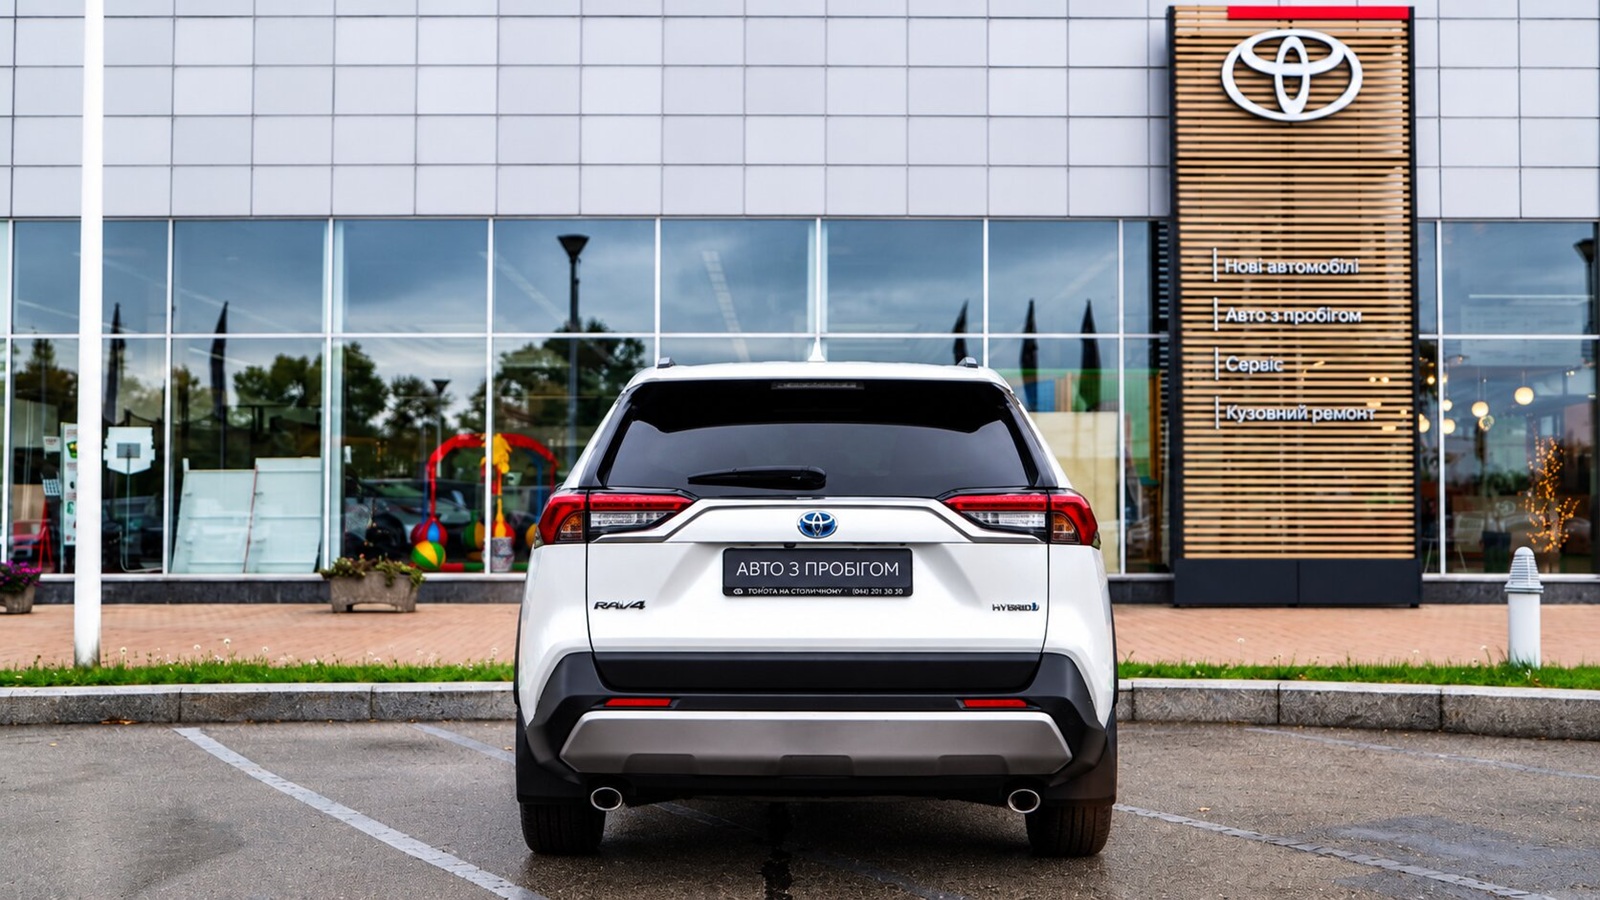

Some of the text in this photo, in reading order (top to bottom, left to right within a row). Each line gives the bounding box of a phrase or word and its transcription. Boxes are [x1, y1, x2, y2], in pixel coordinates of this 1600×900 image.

[1224, 258, 1360, 274] Нові автомобілі
[1225, 306, 1362, 325] Авто з пробігом
[1225, 355, 1284, 375] Сервіс
[1226, 404, 1376, 424] Кузовний ремонт
[736, 561, 900, 577] АВТО З ПРОБІГОМ
[593, 600, 646, 610] RAV4
[992, 603, 1032, 611] HYBRID
